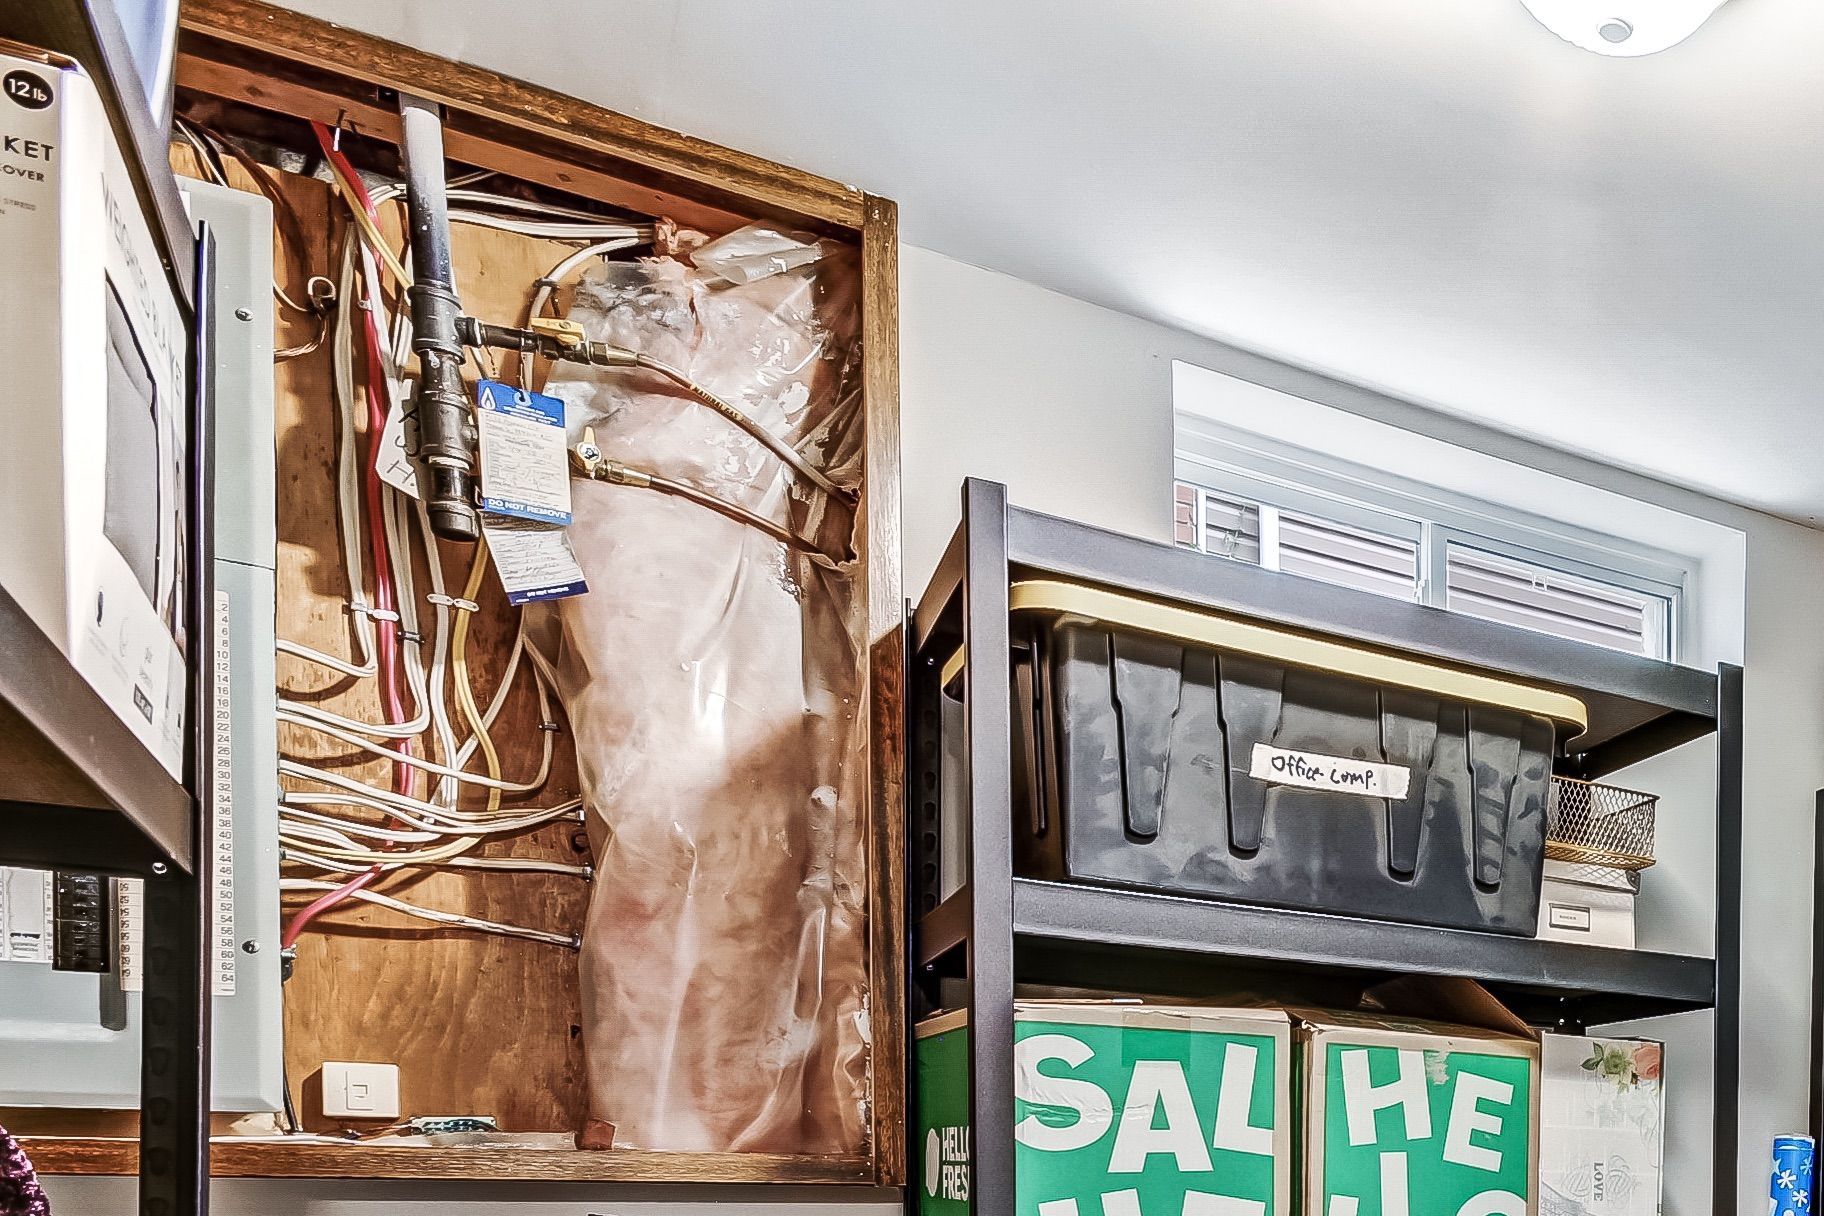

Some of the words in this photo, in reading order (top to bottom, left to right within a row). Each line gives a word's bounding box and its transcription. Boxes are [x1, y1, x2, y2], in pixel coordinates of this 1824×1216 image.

[9, 78, 31, 99] 12
[488, 498, 506, 510] DO
[505, 500, 526, 513] NOT
[526, 503, 569, 521] REMOVE
[217, 651, 229, 659] 10
[217, 663, 229, 671] 12
[217, 675, 229, 684] 14
[217, 686, 229, 695] 16
[218, 711, 230, 719] 20
[218, 734, 230, 743] 24
[218, 759, 230, 768] 28
[1271, 754, 1324, 781] Office
[218, 771, 231, 779] 30
[218, 783, 231, 792] 32
[218, 794, 231, 803] 34
[219, 806, 231, 815] 36
[219, 819, 231, 828] 38
[219, 842, 232, 851] 42
[219, 854, 232, 862] 44
[220, 879, 232, 887] 48
[220, 890, 233, 899] 50
[220, 903, 233, 911] 52
[220, 915, 233, 923] 54
[221, 927, 233, 935] 56
[221, 938, 234, 947] 58
[221, 962, 234, 971] 62
[221, 974, 234, 982] 64
[941, 1126, 970, 1162] HELL
[942, 1164, 970, 1202] FRES
[1593, 1162, 1604, 1202] LOVE
